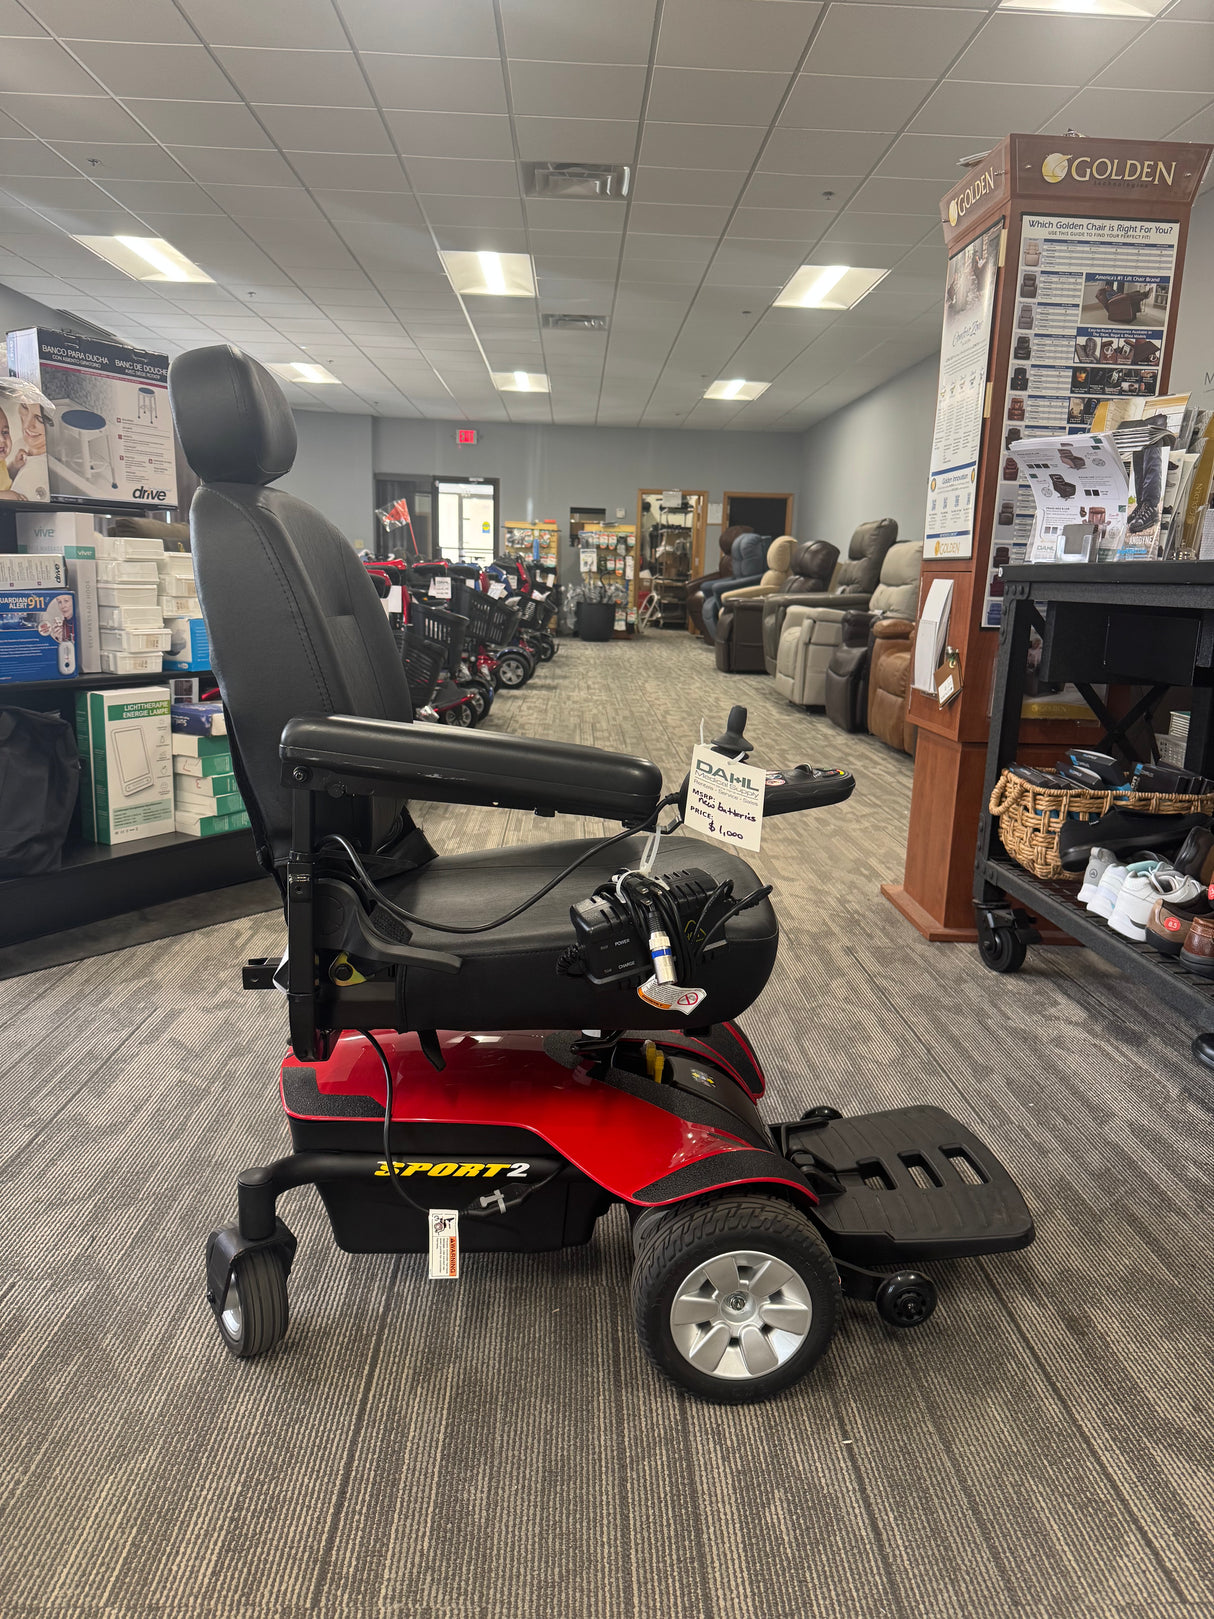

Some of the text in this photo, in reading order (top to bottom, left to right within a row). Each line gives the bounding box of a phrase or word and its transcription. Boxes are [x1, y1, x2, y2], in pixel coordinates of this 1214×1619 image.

[1071, 157, 1177, 186] GOLDEN
[958, 167, 995, 217] GOLDEN
[1028, 219, 1173, 235] Which Golden Chair is Right For You?
[42, 344, 109, 364] BANCO PARA DUCHA
[115, 359, 168, 376] BANC DE DOUCHE
[132, 486, 167, 501] drive
[33, 526, 55, 538] vive
[940, 541, 960, 555] GOLDEN
[54, 563, 62, 584] drive
[27, 596, 45, 609] 911
[123, 707, 169, 719] ENERGIE LAMPE
[124, 700, 169, 711] LICHTTHERAPIE
[696, 759, 759, 792] DAHL
[695, 770, 760, 799] Medical Supply
[692, 788, 716, 803] MSRP:
[698, 797, 716, 809] new
[690, 805, 714, 820] PRICE:
[708, 820, 716, 833] $
[1167, 921, 1177, 929] 8.5
[614, 938, 631, 947] POWER
[618, 960, 636, 970] CHARGE
